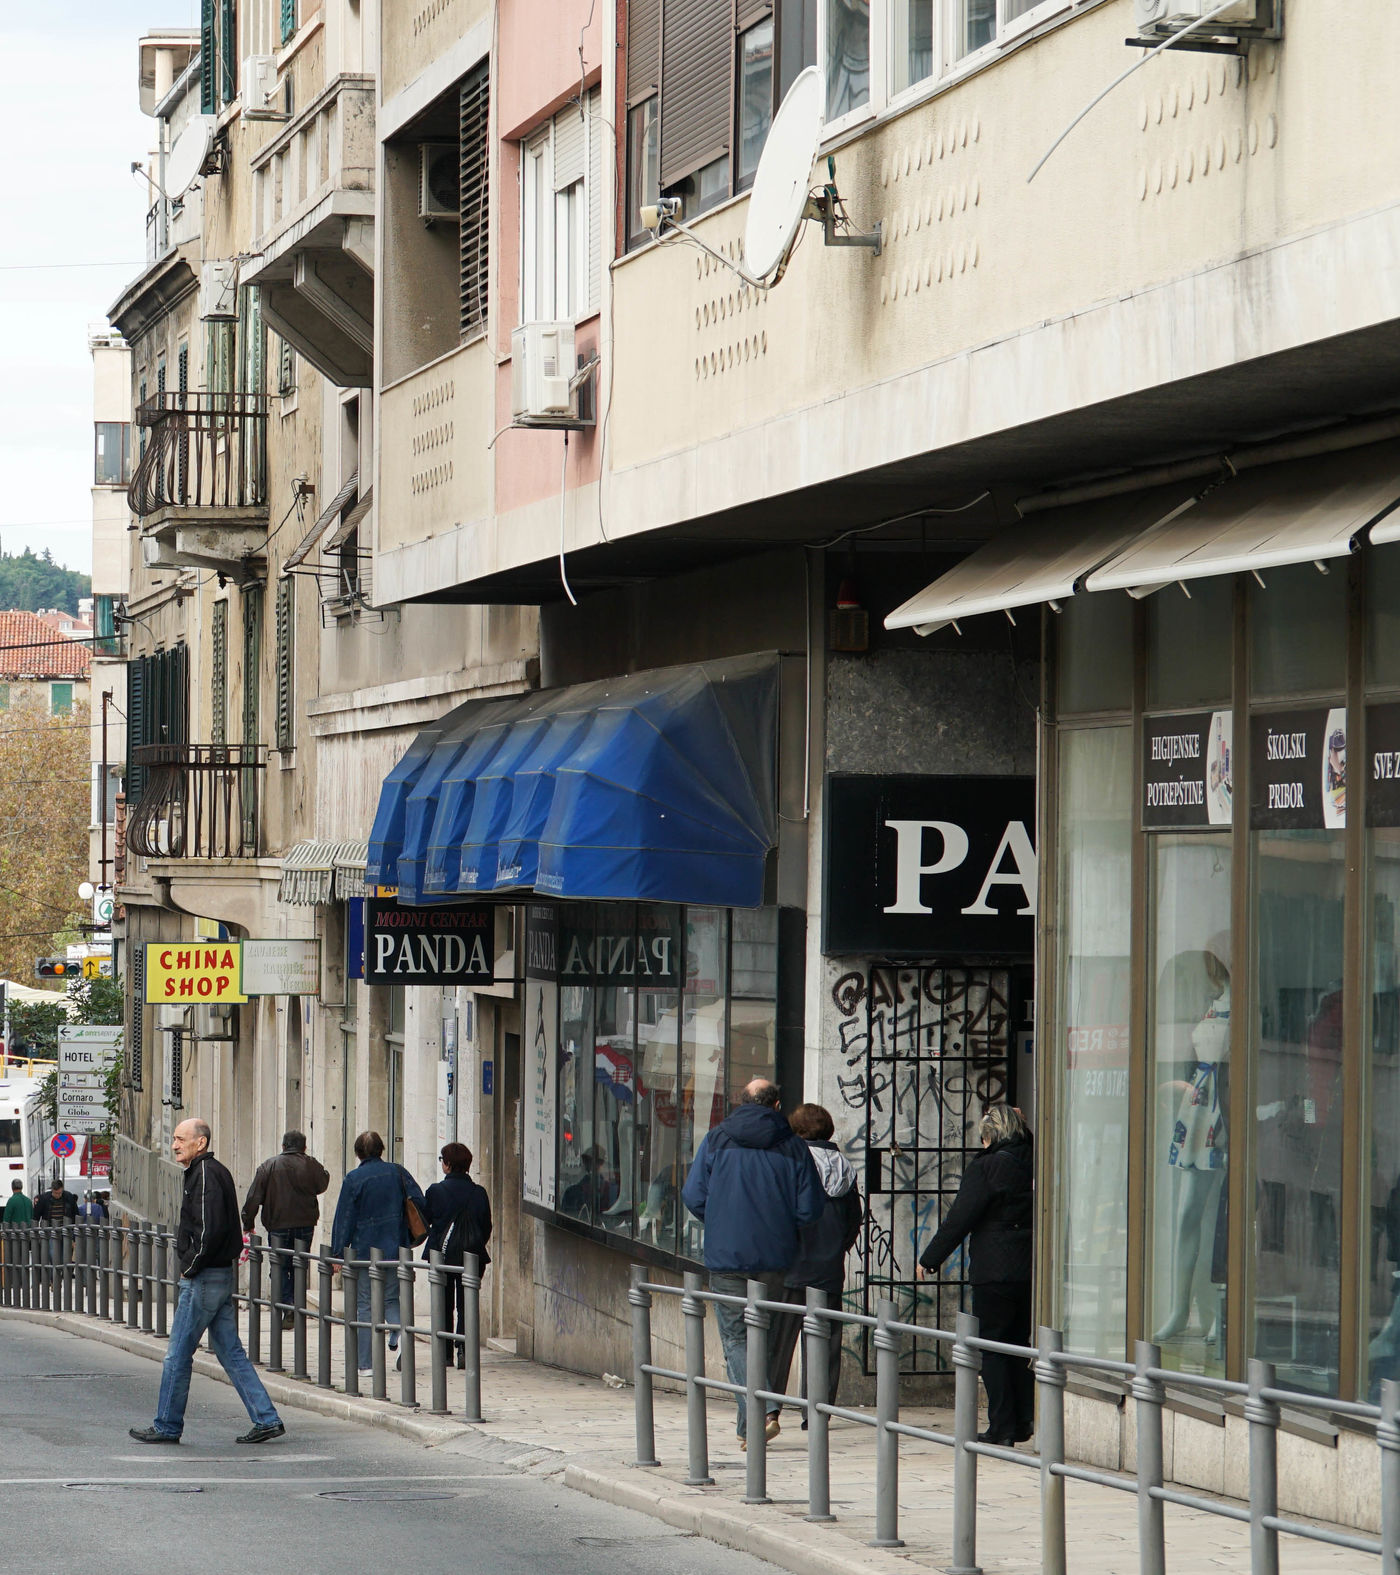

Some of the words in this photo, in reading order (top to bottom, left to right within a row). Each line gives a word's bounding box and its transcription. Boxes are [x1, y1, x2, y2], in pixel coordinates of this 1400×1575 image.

[1151, 733, 1200, 767] HIGIJENSKE
[1267, 728, 1306, 760] ŠKOLSKI
[1374, 752, 1393, 780] SVE
[1147, 775, 1204, 806] POTREPŠTINE
[1268, 783, 1304, 809] PRIBOR
[375, 911, 426, 928] MODNI
[429, 912, 488, 928] CENTAR
[160, 949, 234, 970] CHINA
[374, 933, 490, 974] PANDA
[529, 930, 556, 971] PANDA
[165, 976, 230, 996] SHOP
[64, 1052, 94, 1063] HOTEL
[62, 1092, 94, 1102] Cornaro
[67, 1108, 90, 1116] Globo
